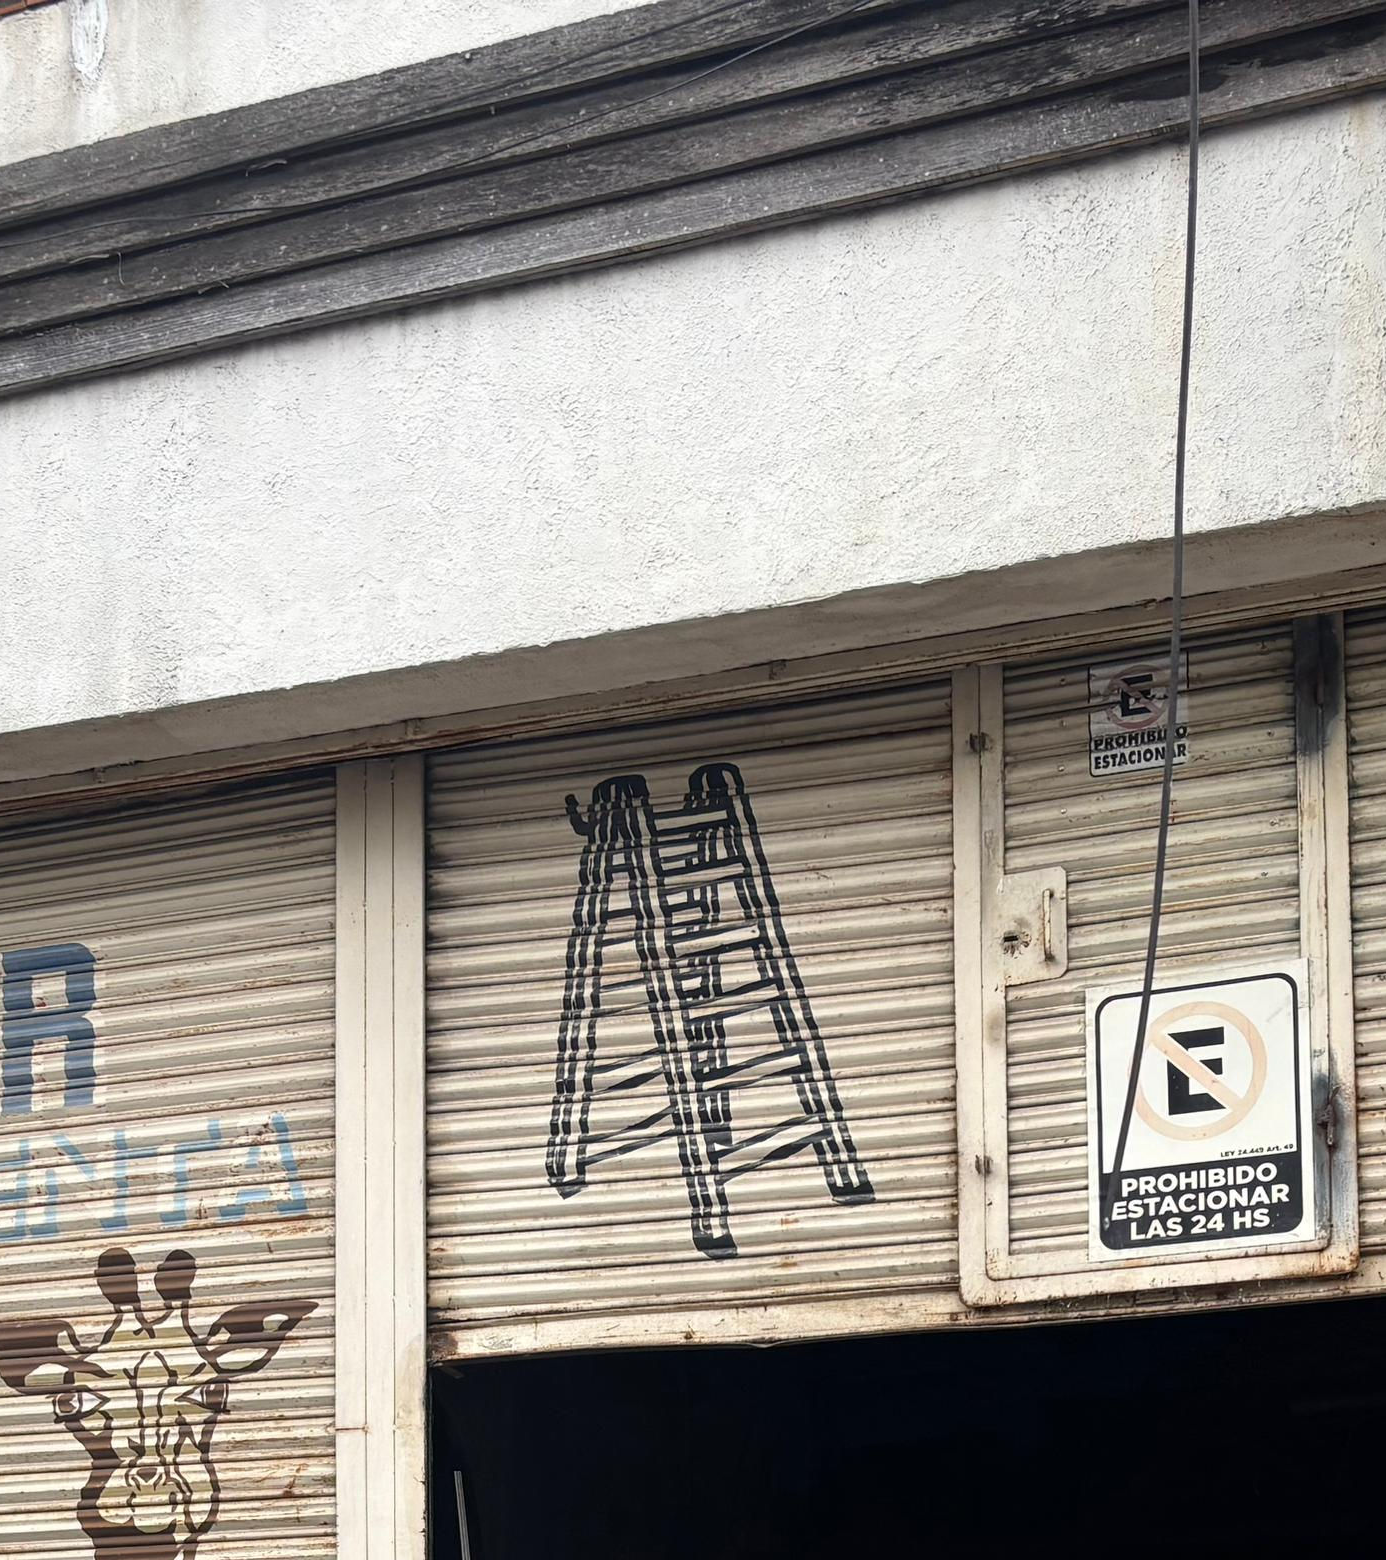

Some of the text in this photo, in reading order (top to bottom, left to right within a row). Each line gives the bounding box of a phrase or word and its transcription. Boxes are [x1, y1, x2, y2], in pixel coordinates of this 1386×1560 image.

[1094, 726, 1187, 750] PROHIBIO
[1121, 1162, 1277, 1197] PROHIBIDO
[1112, 1184, 1290, 1221] ESTACIONAR
[1130, 1208, 1270, 1240] LAS 24 HS
